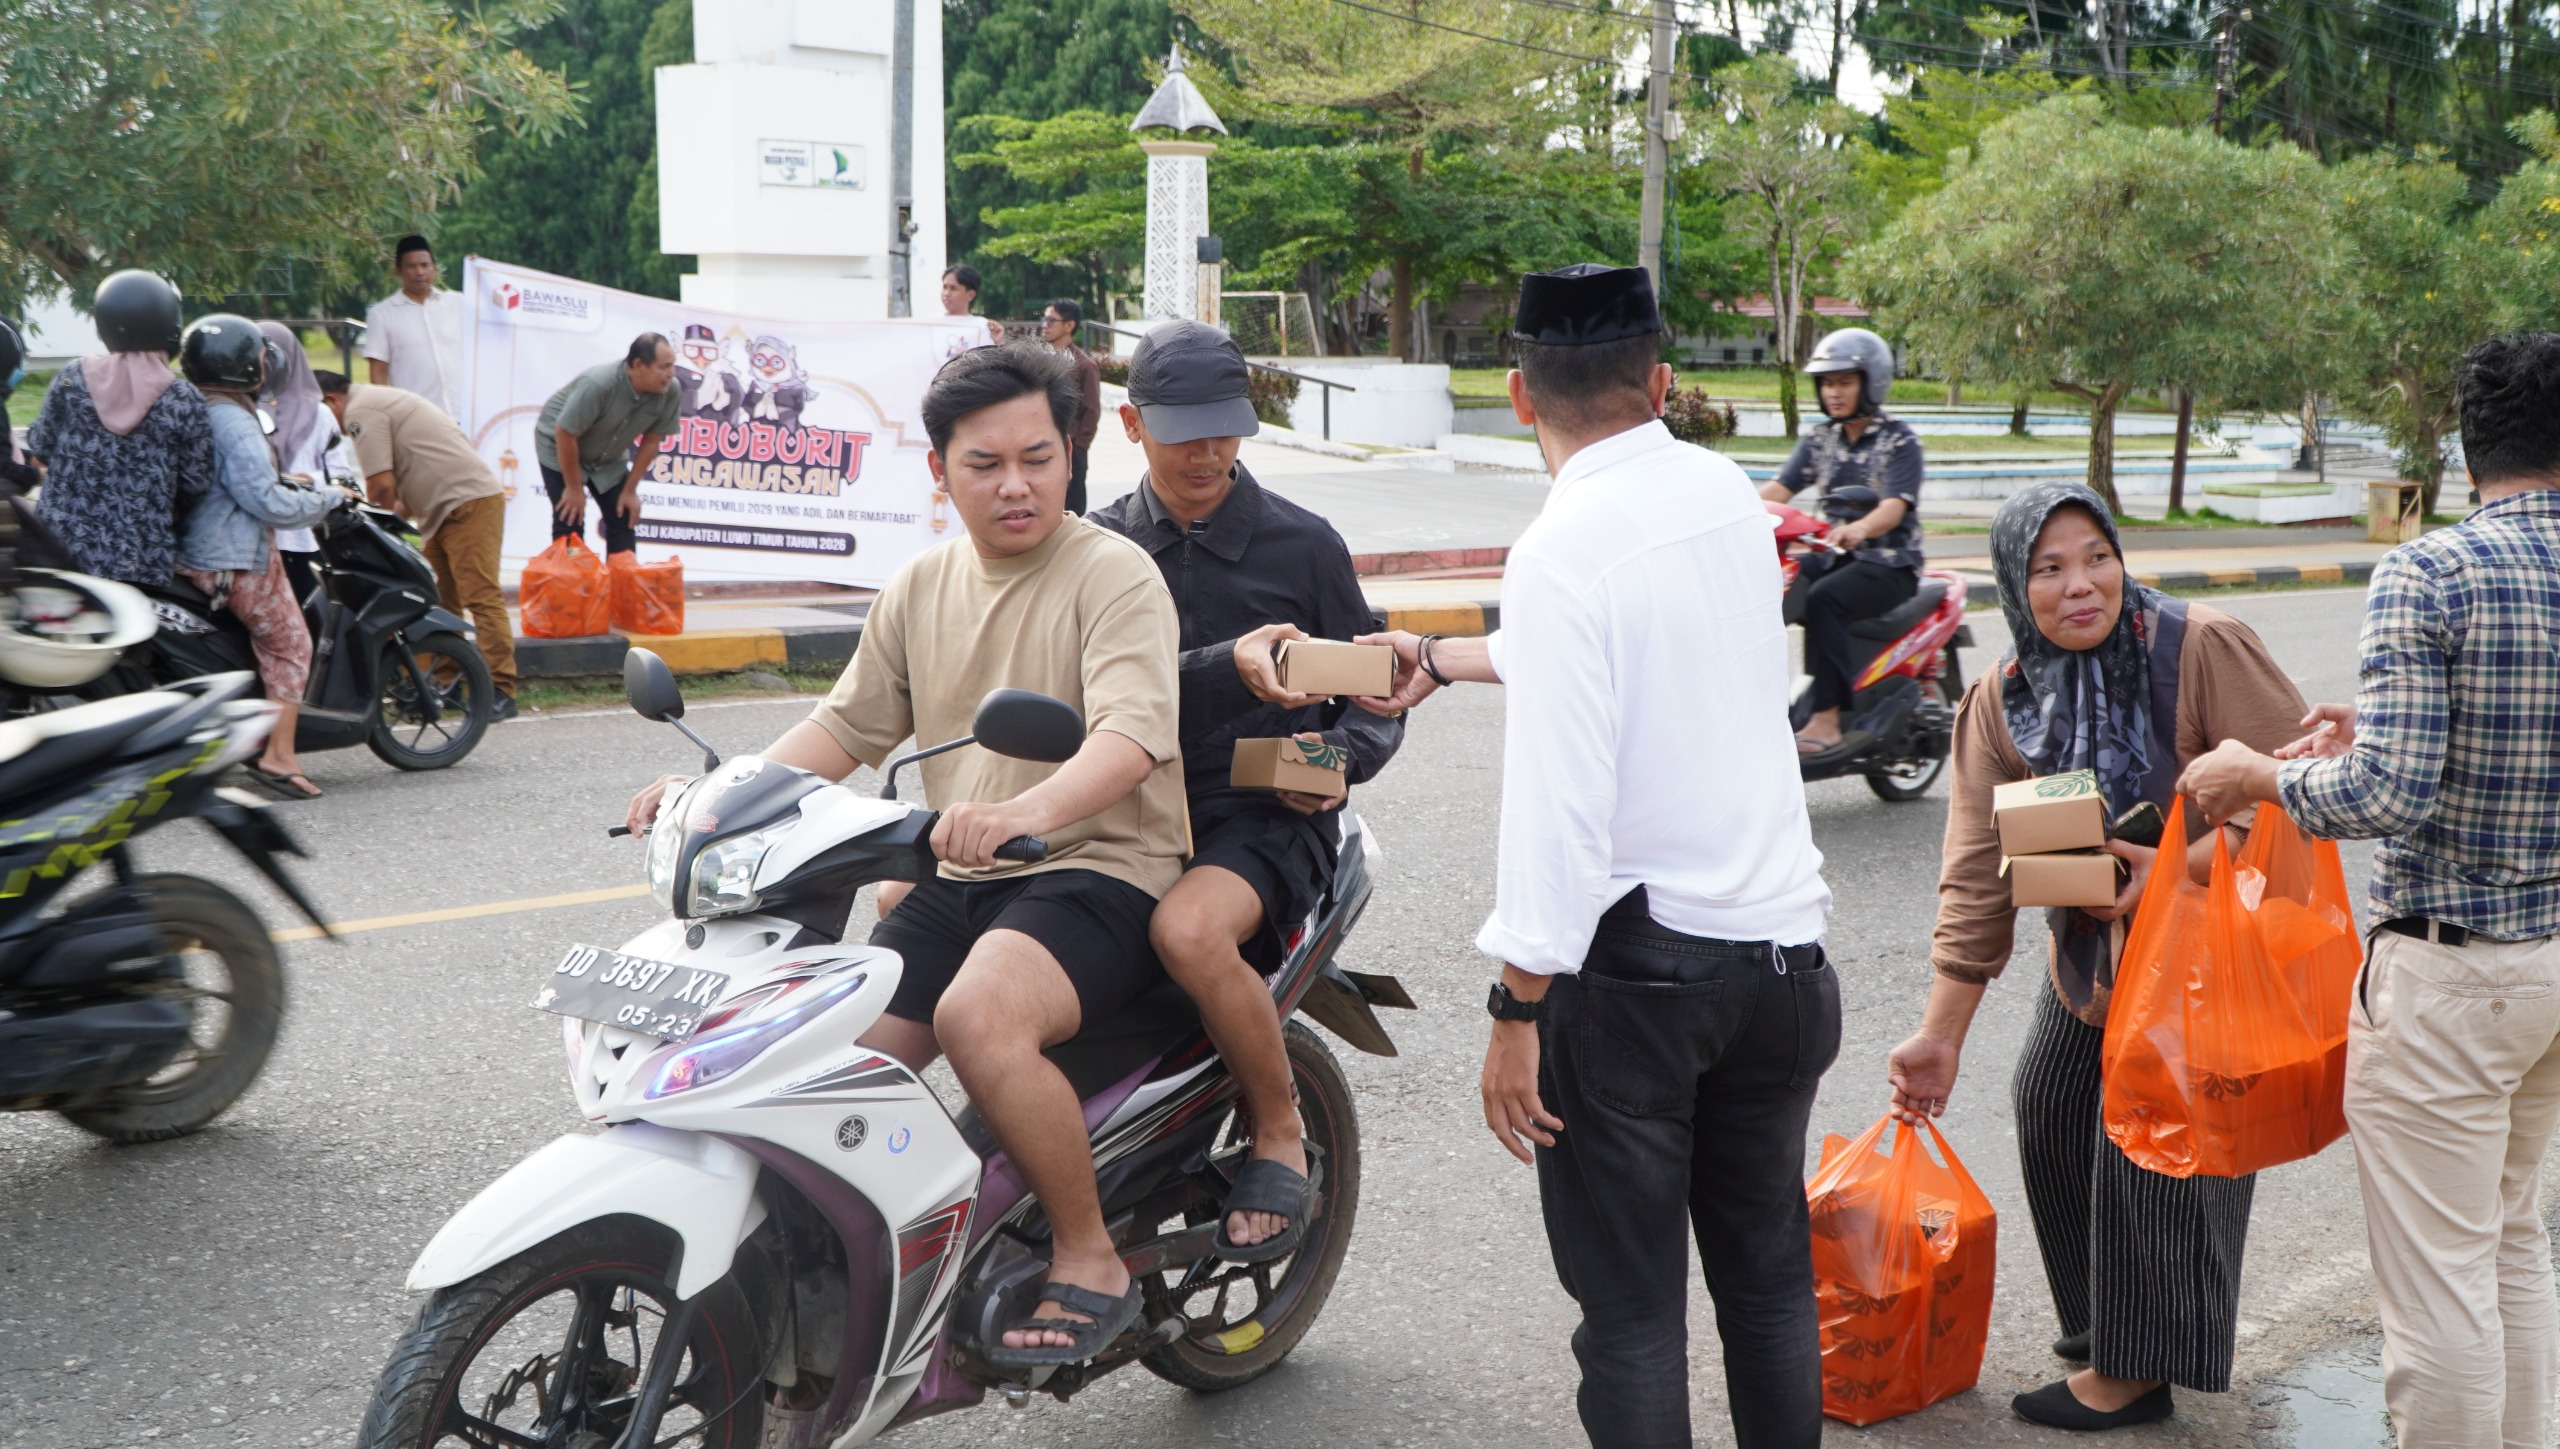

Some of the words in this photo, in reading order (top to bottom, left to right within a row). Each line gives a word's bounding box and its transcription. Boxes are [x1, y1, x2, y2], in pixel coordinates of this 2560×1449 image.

[523, 289, 588, 309] BAWASLU
[634, 417, 872, 485] ABUBURIT
[628, 454, 841, 497] ENGAWASAN
[667, 496, 707, 509] MENUJU
[709, 499, 745, 513] PEMILU
[747, 503, 773, 514] 2029
[775, 505, 801, 517] YANG
[803, 507, 824, 519] ADIL
[826, 509, 846, 520] DAN
[659, 525, 721, 543] KABUPATEN
[721, 530, 751, 545] LUWU
[753, 533, 784, 548] TIMUR
[786, 535, 818, 550] TAHUN
[818, 537, 847, 552] 2026
[556, 945, 599, 977] DD
[600, 955, 675, 994] 3697
[673, 970, 725, 1008] XK
[770, 1079, 802, 1095] FUEL
[806, 1053, 867, 1081] INJECTION
